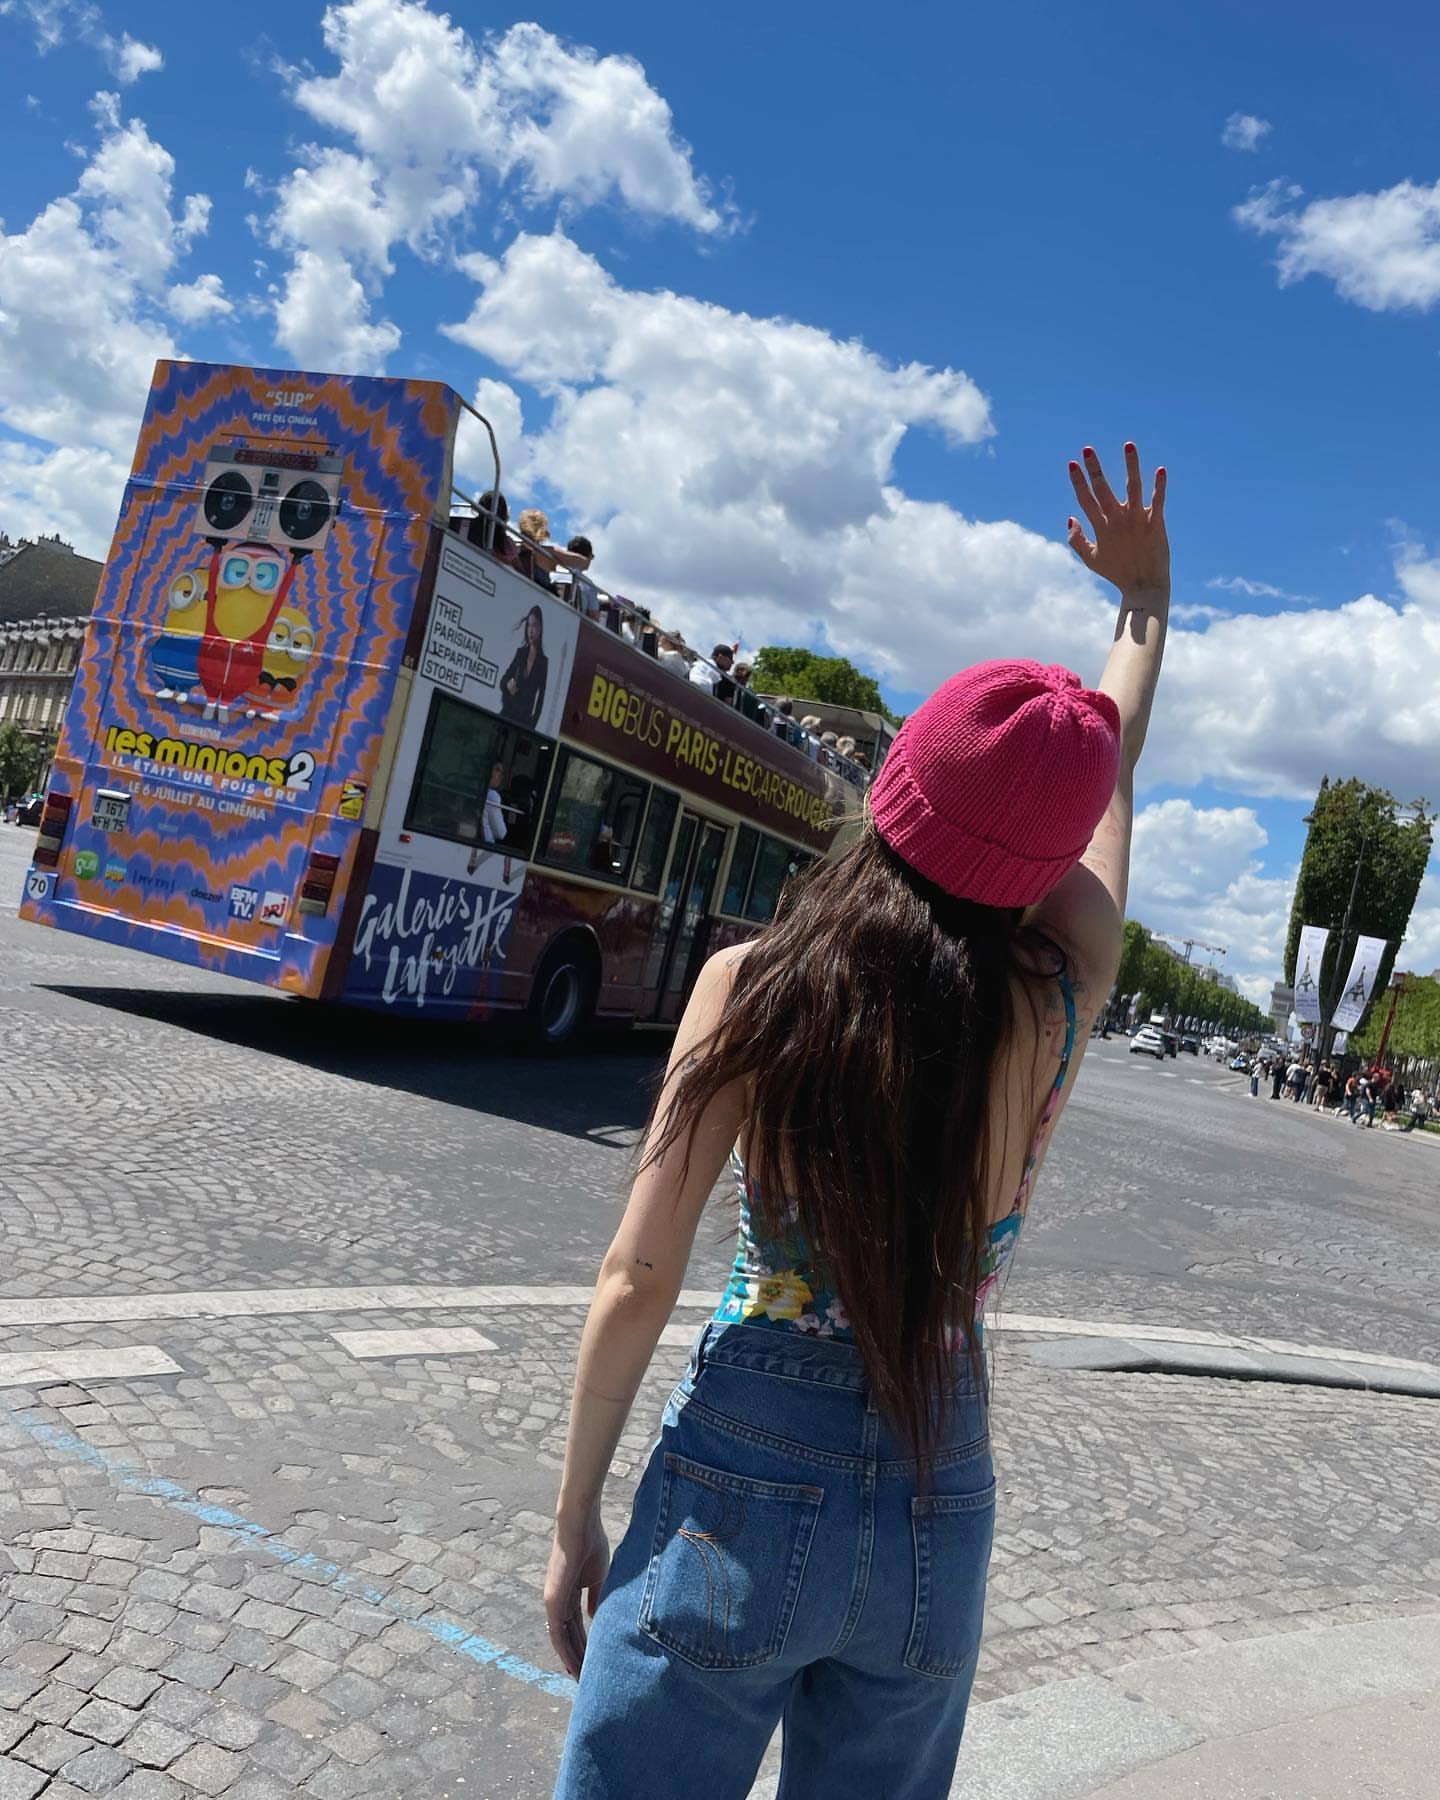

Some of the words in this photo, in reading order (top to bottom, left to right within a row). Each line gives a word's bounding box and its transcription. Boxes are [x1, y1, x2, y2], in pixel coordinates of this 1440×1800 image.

[438, 602, 459, 624] THE
[433, 622, 481, 654] PARISIAN
[425, 659, 461, 686] STORE
[665, 718, 720, 776] PARIS
[111, 756, 125, 768] IL
[133, 758, 176, 778] ÉTAIT
[183, 771, 213, 786] UNE
[220, 778, 257, 794] FOIS
[264, 787, 298, 803] GRU
[286, 751, 316, 791] 2
[128, 780, 142, 794] LE
[142, 783, 151, 795] 6
[151, 785, 195, 806] JUILLET
[197, 797, 214, 811] AU
[218, 799, 267, 821] CINÉMA
[30, 878, 47, 894] 70
[231, 887, 258, 905] BFM
